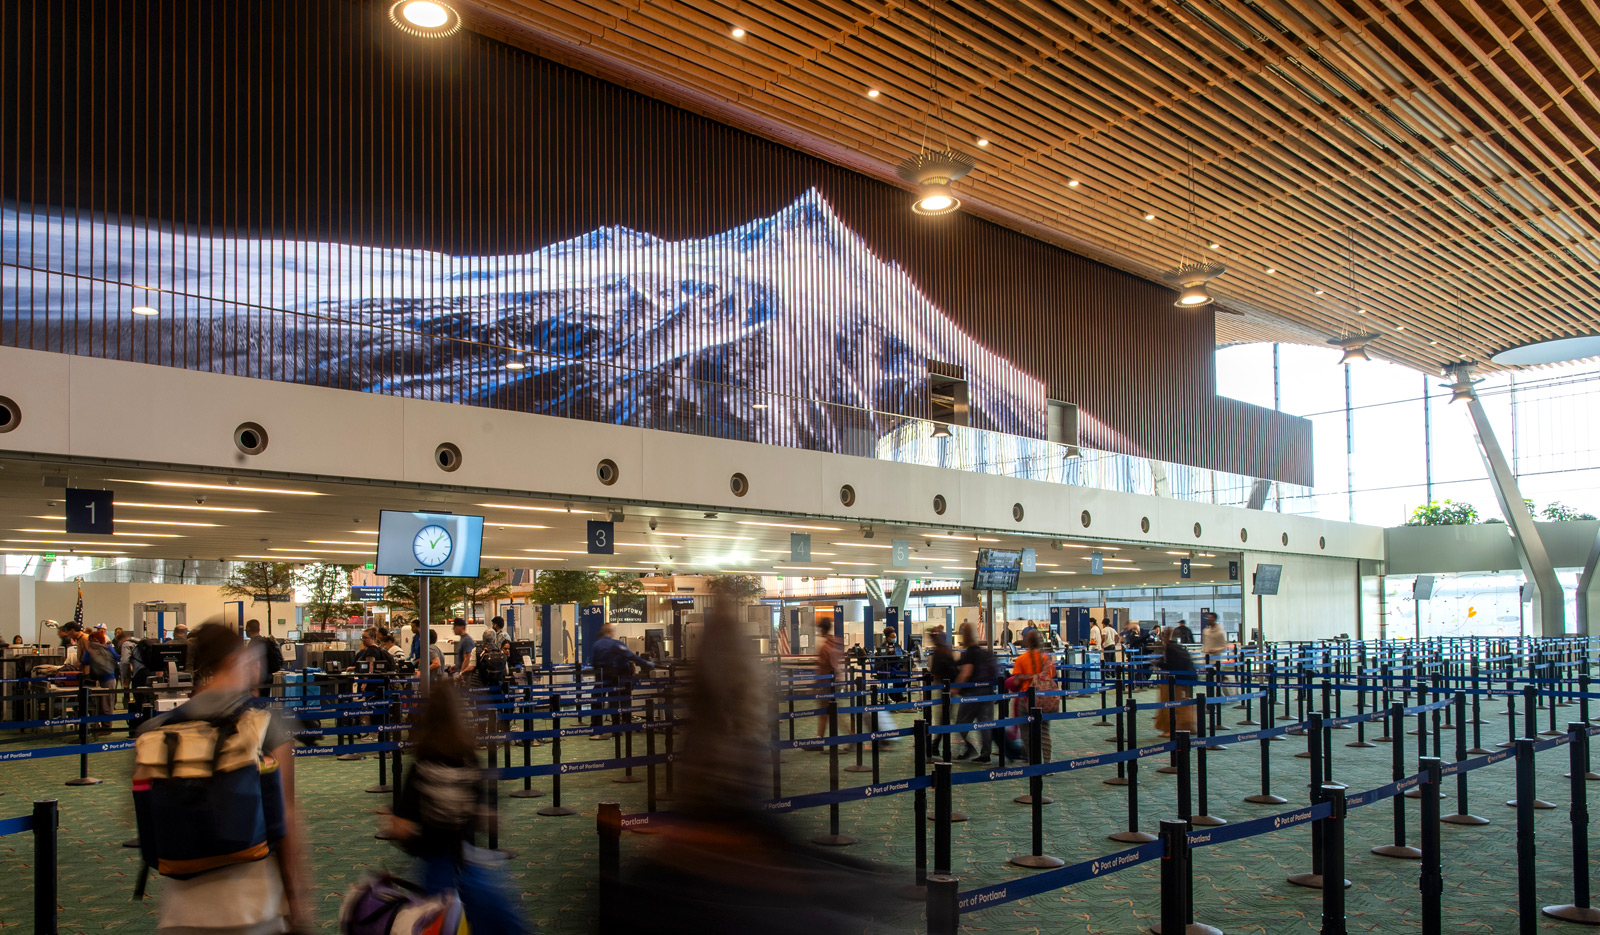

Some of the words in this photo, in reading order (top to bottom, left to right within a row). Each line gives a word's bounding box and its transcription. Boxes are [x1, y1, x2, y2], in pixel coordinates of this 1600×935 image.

[85, 502, 95, 524] 1
[596, 530, 606, 547] 3
[797, 541, 804, 555] 4
[897, 547, 904, 560] 5
[1026, 554, 1032, 567] 6
[1094, 557, 1099, 569] 7
[1183, 564, 1188, 574] 8
[1232, 566, 1235, 576] 9
[890, 782, 908, 791] Portland
[768, 800, 791, 809] Portland
[621, 817, 649, 826] Portland
[1295, 811, 1312, 822] Portland
[1191, 833, 1210, 843] Portland
[1101, 861, 1111, 870] Port
[1119, 852, 1139, 866] Portland
[959, 898, 968, 908] ort
[970, 895, 977, 906] of
[979, 888, 1006, 903] Portland
